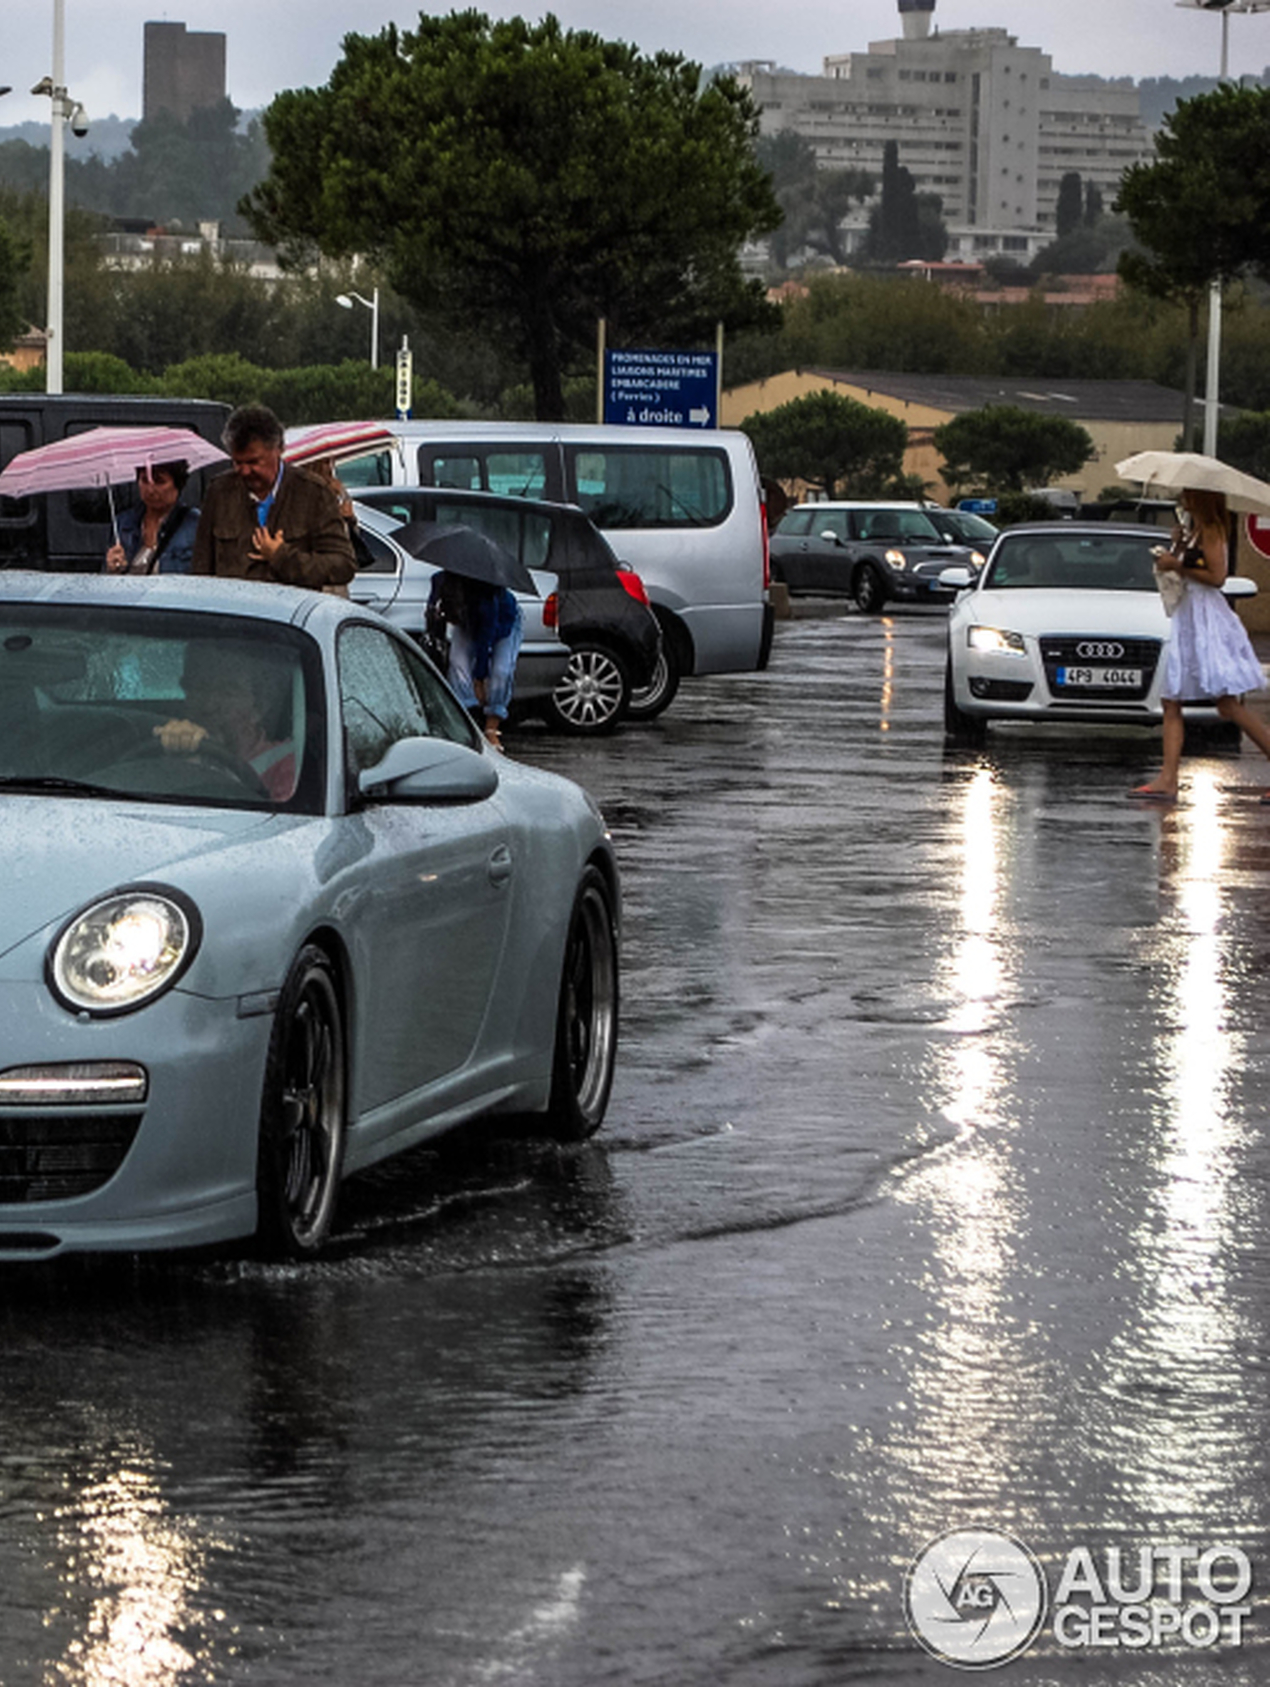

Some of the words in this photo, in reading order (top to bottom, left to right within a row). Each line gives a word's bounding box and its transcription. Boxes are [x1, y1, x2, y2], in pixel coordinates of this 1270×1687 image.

[611, 353, 675, 365] PROMENADES
[677, 355, 690, 365] EN
[692, 355, 712, 366] MER
[611, 366, 656, 377] LIAISONS
[657, 367, 707, 378] MARITIMES
[626, 406, 636, 423] à
[639, 407, 683, 423] droite
[1103, 670, 1135, 684] 4044
